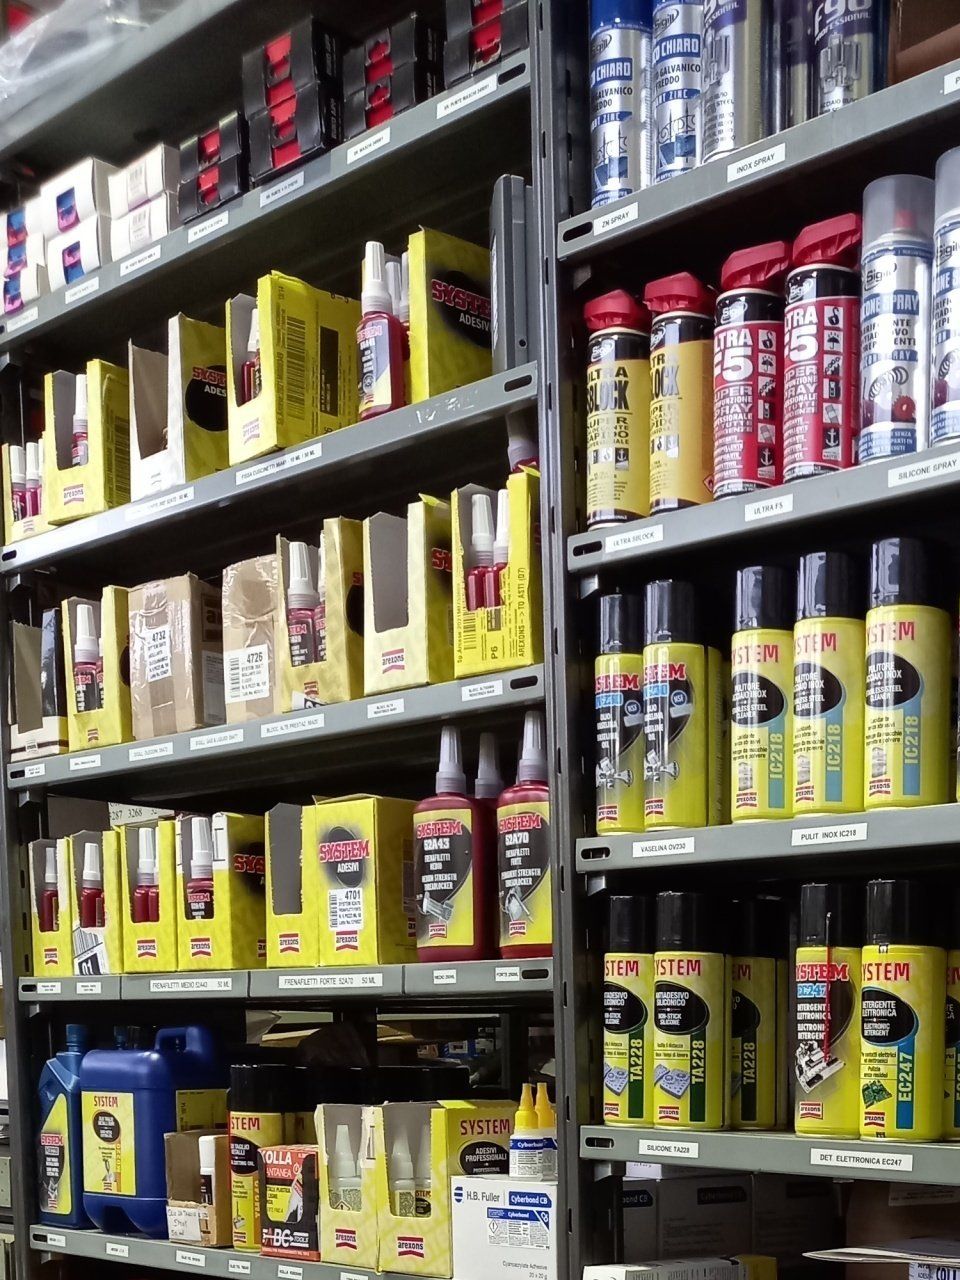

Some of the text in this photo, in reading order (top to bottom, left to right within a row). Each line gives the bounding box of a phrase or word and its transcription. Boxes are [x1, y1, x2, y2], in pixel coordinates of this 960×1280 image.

[736, 153, 774, 173] INOX SPRAY
[601, 211, 629, 227] ZN SPRAY
[898, 459, 956, 479] SILICONE SPRAY
[839, 829, 856, 837] IC218
[319, 839, 370, 863] SYSTEM
[835, 1155, 880, 1164] ELETTRONICA
[466, 1190, 500, 1202] H.B. Fuller
